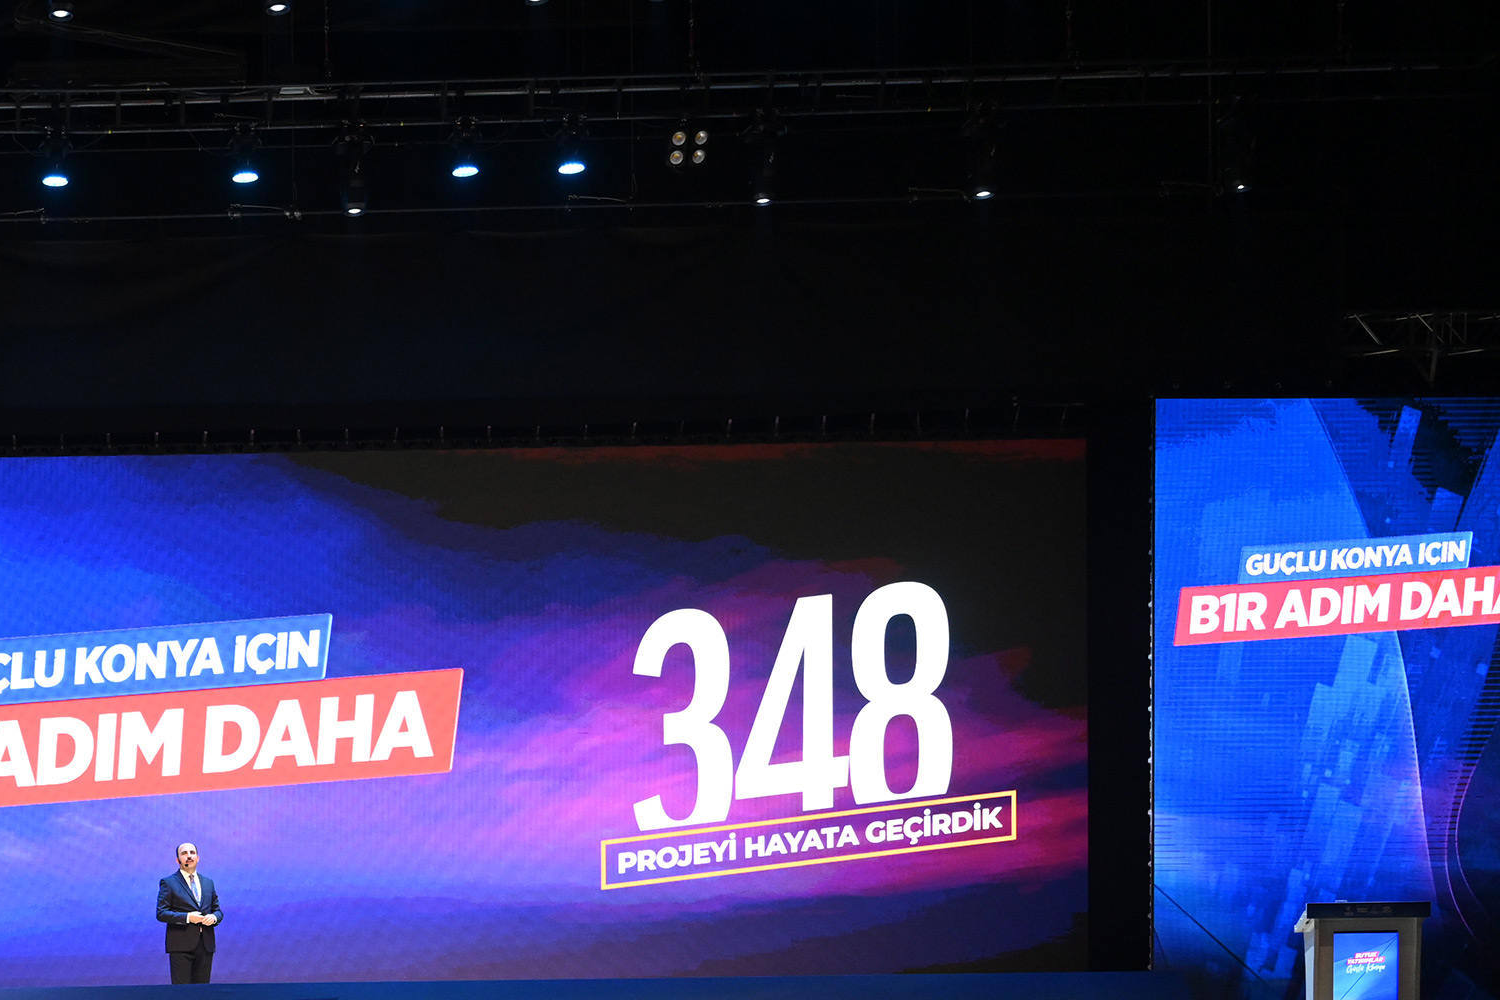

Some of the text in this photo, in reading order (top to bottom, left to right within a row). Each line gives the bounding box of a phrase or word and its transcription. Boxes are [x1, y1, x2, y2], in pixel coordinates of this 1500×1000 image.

[1330, 544, 1413, 570] KONYA
[1189, 576, 1500, 635] B1R ADIM DAH
[74, 637, 225, 685] KONYA
[202, 690, 434, 774] DAHA
[632, 581, 954, 832] 348
[617, 802, 1003, 875] PROJEYİ HAYATA GEÇİRDİK
